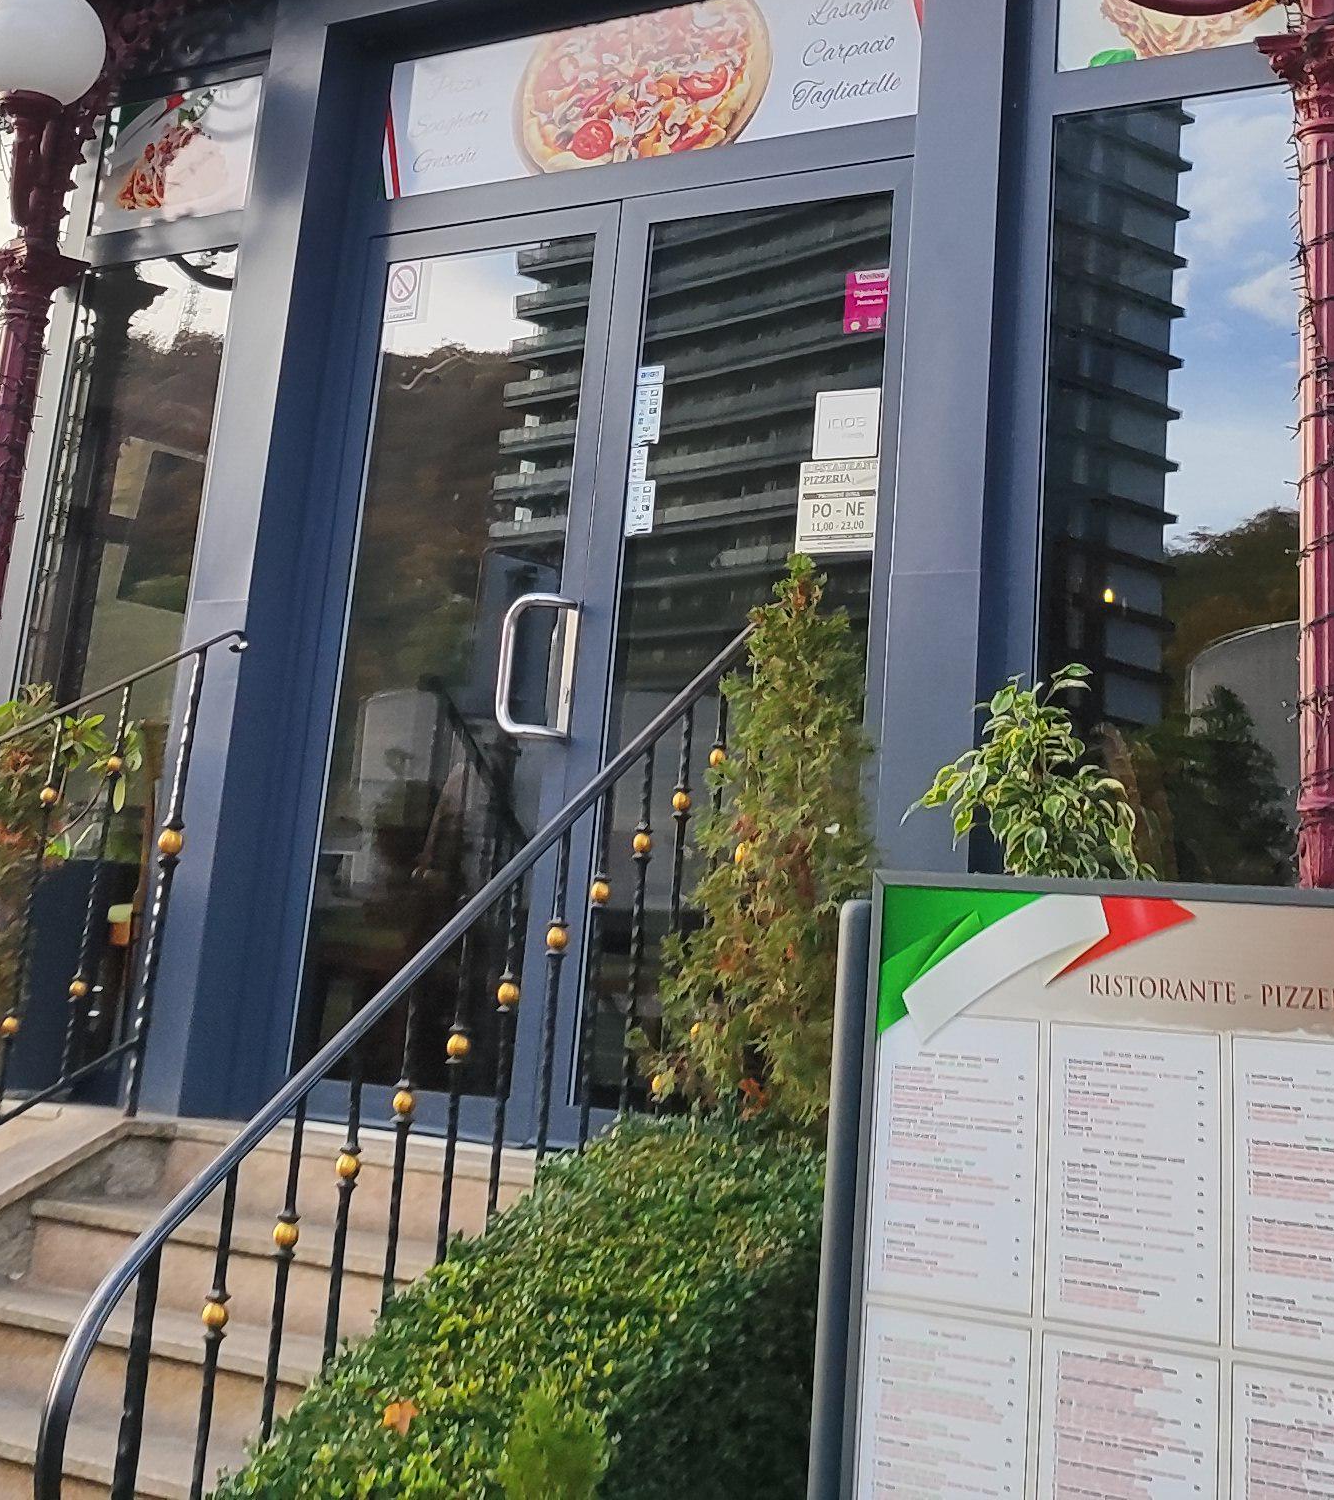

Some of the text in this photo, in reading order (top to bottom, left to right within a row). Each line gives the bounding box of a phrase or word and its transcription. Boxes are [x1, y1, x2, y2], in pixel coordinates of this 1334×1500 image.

[792, 72, 901, 110] Tagliatelle
[804, 474, 851, 486] PIZZERIA
[812, 503, 832, 518] PO
[846, 502, 866, 517] NE
[1089, 973, 1237, 1005] RISTORANTE
